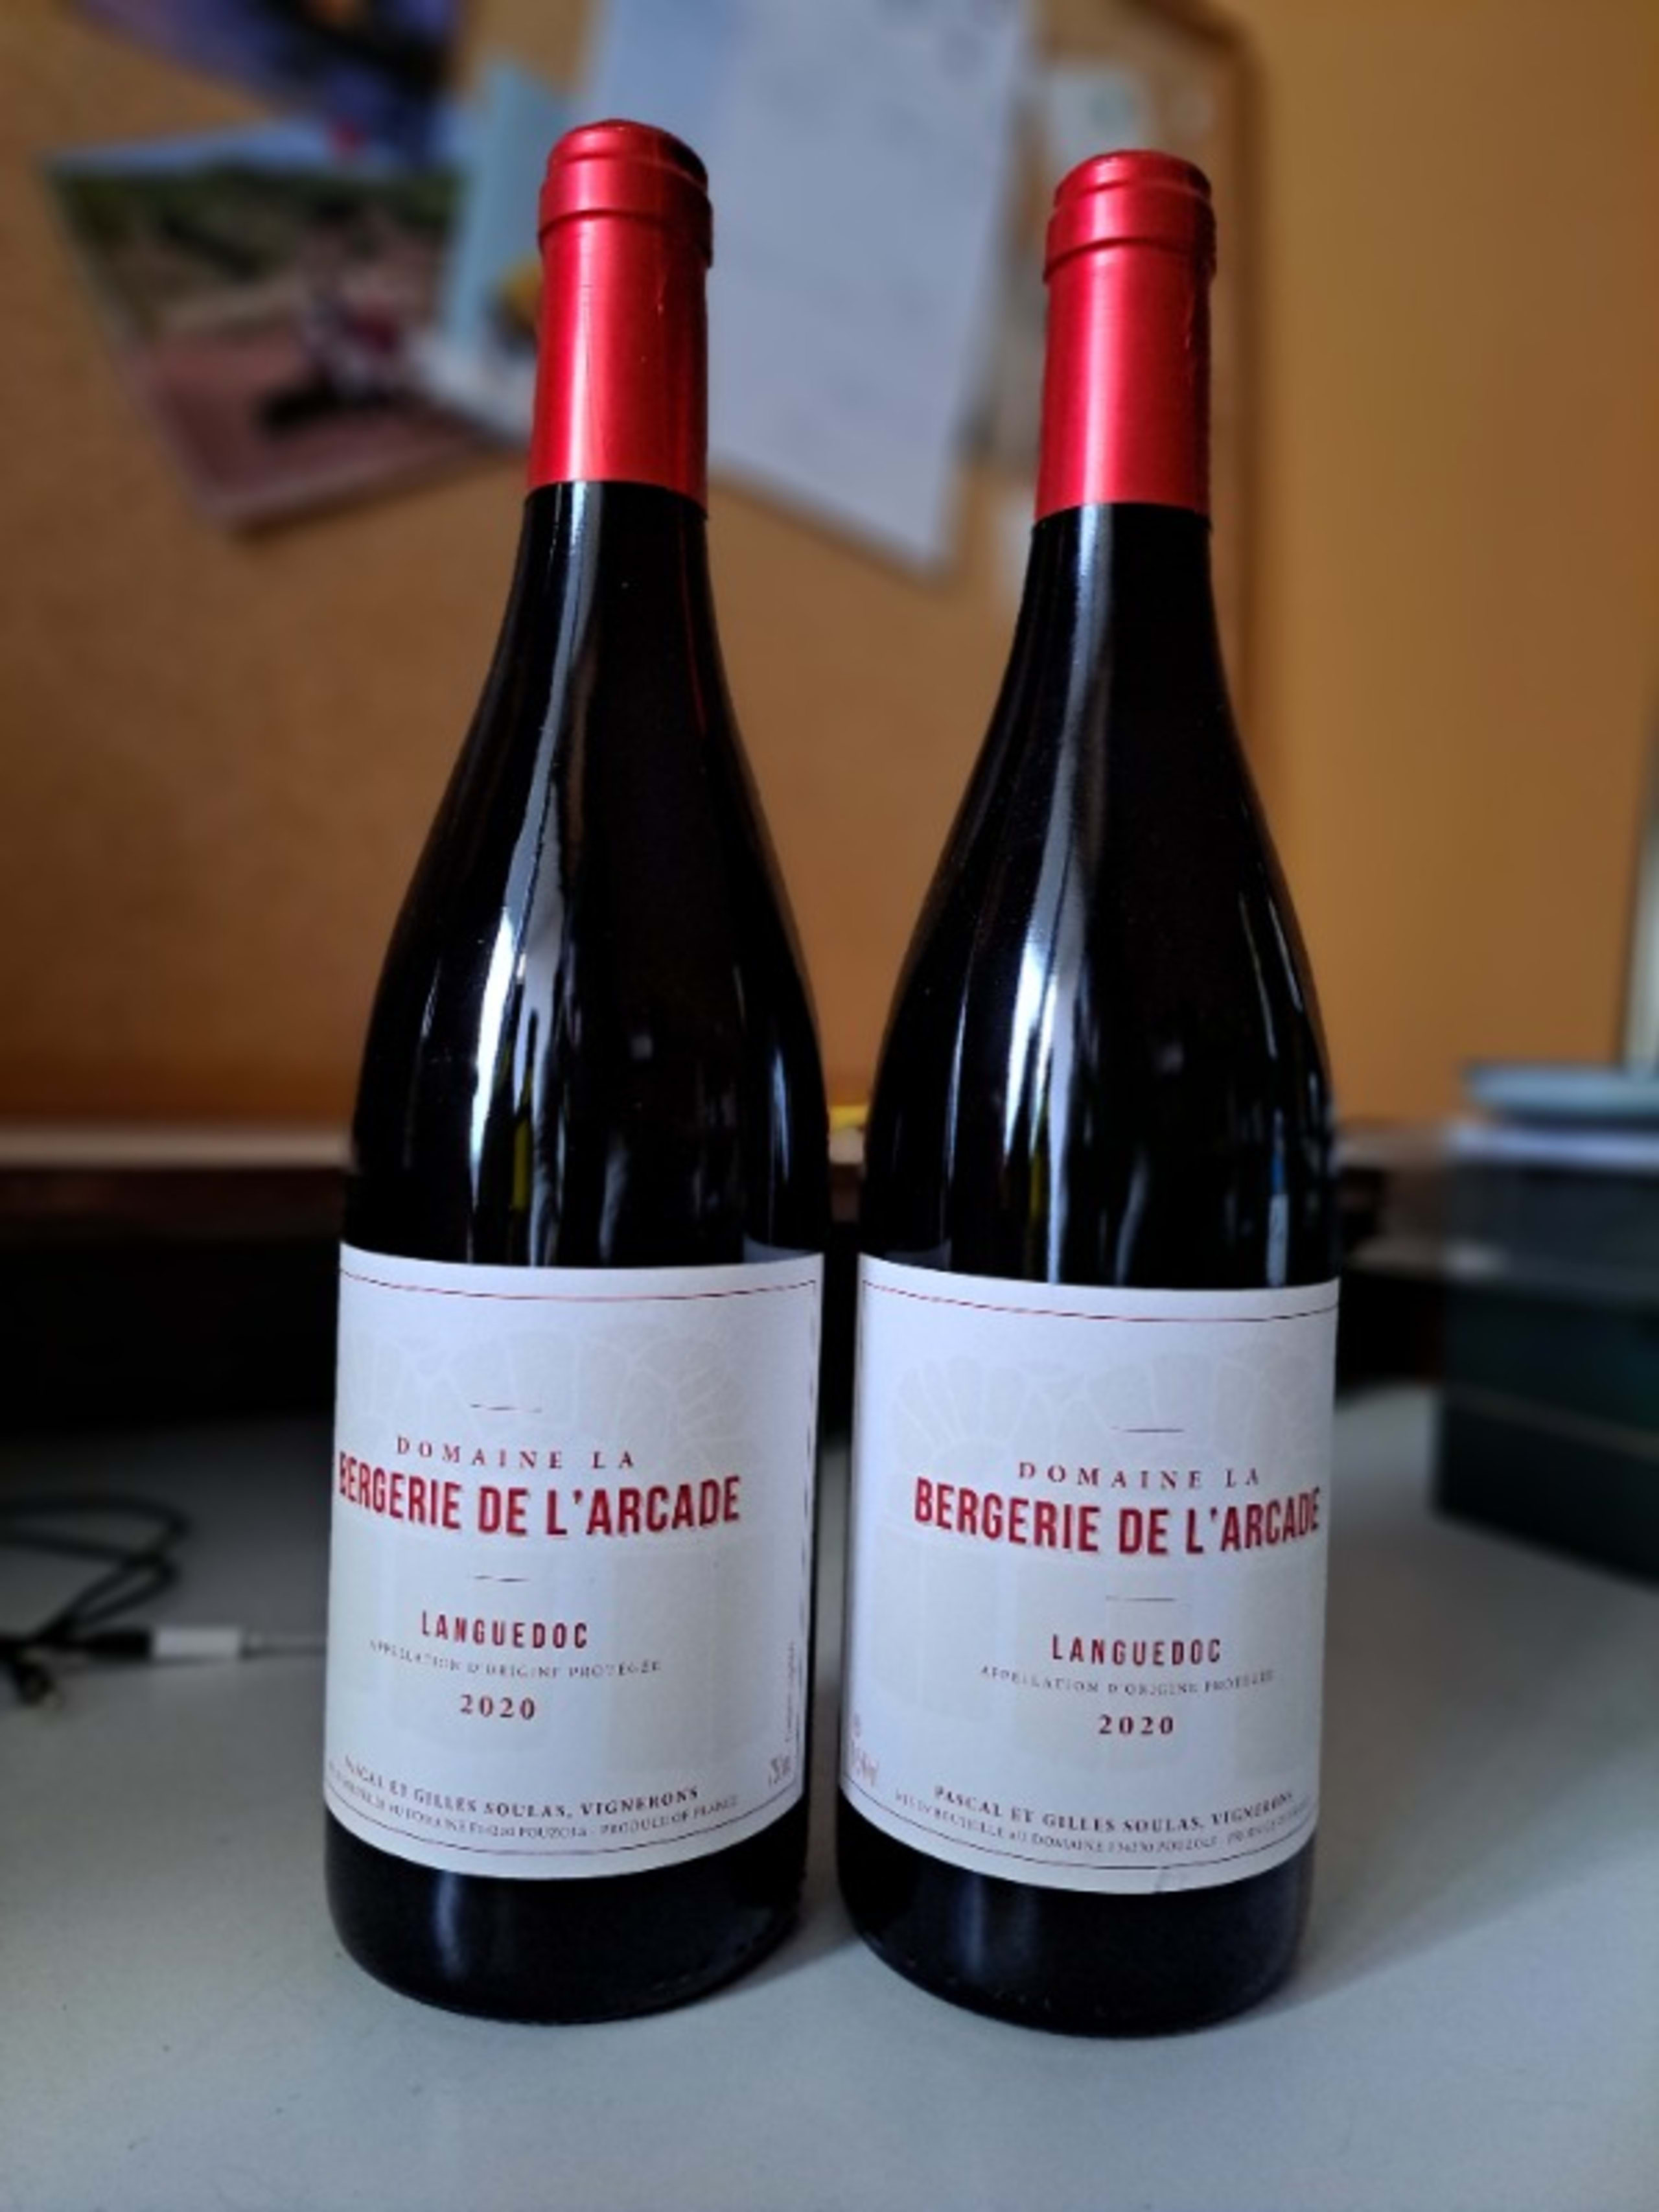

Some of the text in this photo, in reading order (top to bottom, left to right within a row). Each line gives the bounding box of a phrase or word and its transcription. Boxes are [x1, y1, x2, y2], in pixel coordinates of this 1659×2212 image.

[397, 1435, 634, 1470] DOMAINE LA
[1019, 1461, 1259, 1489] DOMAINE LA
[339, 1450, 741, 1537] BERGERIE DE L'ARCADE
[914, 1476, 1320, 1555] BERGERIE DE L'ARCADE
[421, 1610, 588, 1649] LANGUEDOC
[1052, 1634, 1221, 1666] LANGUEDOC
[460, 1694, 536, 1721] 2020
[1099, 1714, 1174, 1735] 2020
[414, 1788, 476, 1813] GILLES
[483, 1800, 573, 1819] SOULAS,
[579, 1785, 698, 1816] VIGNERONS
[934, 1784, 1003, 1817] PASCAL
[1011, 1806, 1034, 1823] ET
[1041, 1813, 1115, 1833] GILLES
